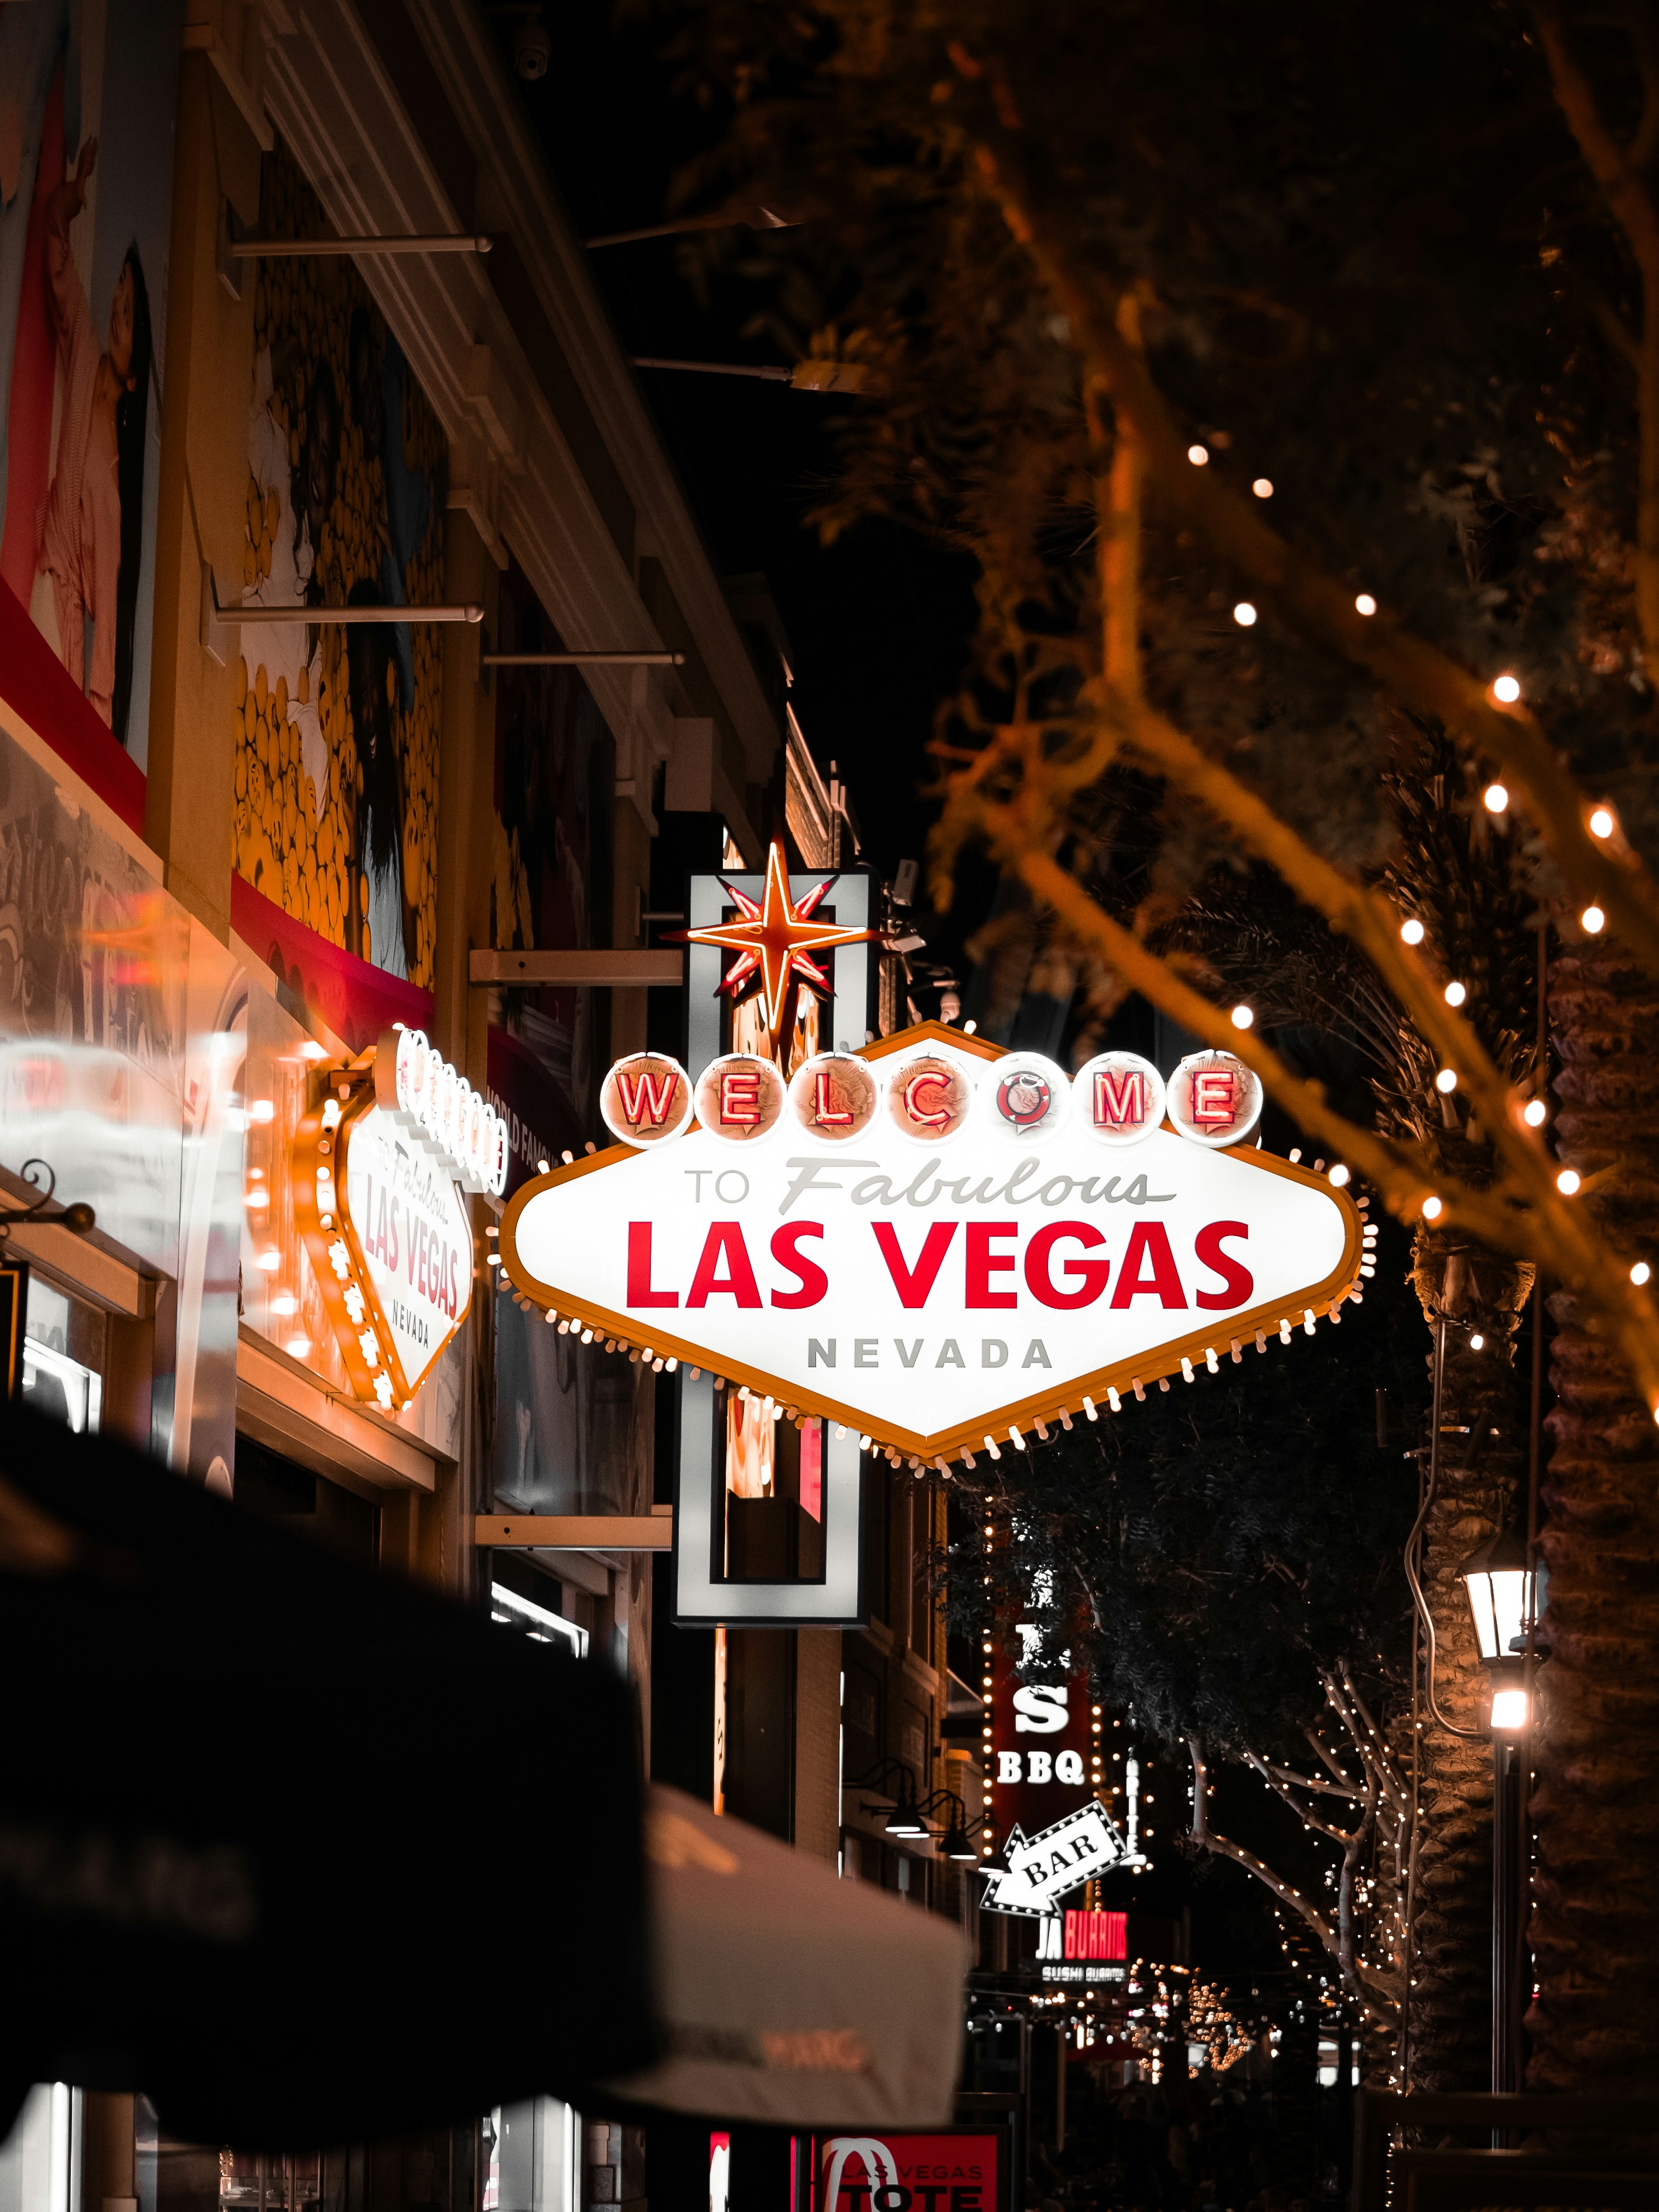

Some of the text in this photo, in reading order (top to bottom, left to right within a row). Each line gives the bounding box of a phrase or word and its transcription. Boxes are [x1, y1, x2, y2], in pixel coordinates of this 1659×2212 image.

[615, 1070, 1236, 1127] WELCOME
[521, 1123, 559, 1175] FAMO
[393, 1139, 448, 1226] Fabulous
[684, 1156, 1177, 1216] TO Fabulous
[366, 1173, 458, 1321] LAS VEGAS
[626, 1220, 1254, 1311] LAS VEGAS
[392, 1298, 429, 1349] NEVADA
[807, 1338, 1053, 1369] NEVADA
[997, 1750, 1085, 1786] BBQ
[1021, 1834, 1098, 1888] BAR
[838, 2184, 982, 2212] TOTE
[842, 2165, 982, 2180] LAS VEGAS
